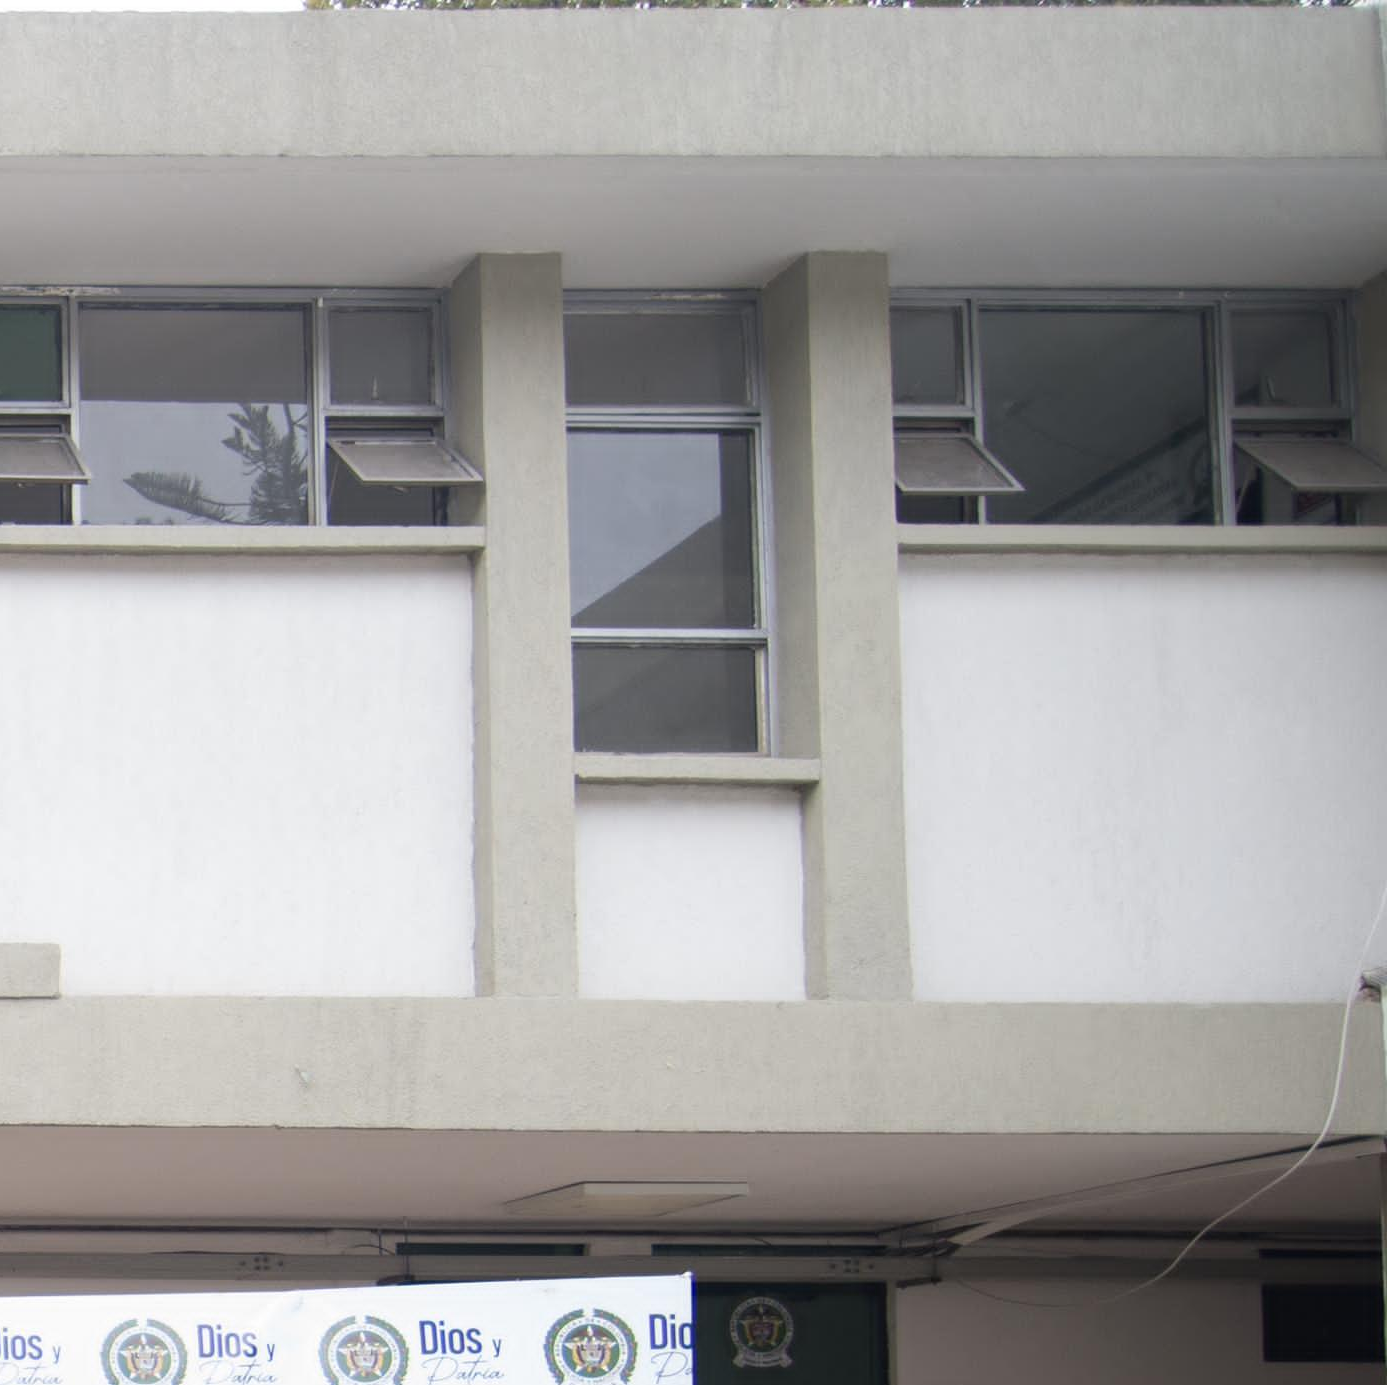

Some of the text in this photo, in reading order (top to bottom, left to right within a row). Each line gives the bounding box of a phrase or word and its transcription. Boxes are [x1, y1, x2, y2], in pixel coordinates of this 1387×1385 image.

[197, 1325, 275, 1362] Dios y
[419, 1320, 501, 1357] Dios y
[649, 1314, 693, 1350] Dio
[53, 1347, 60, 1364] y
